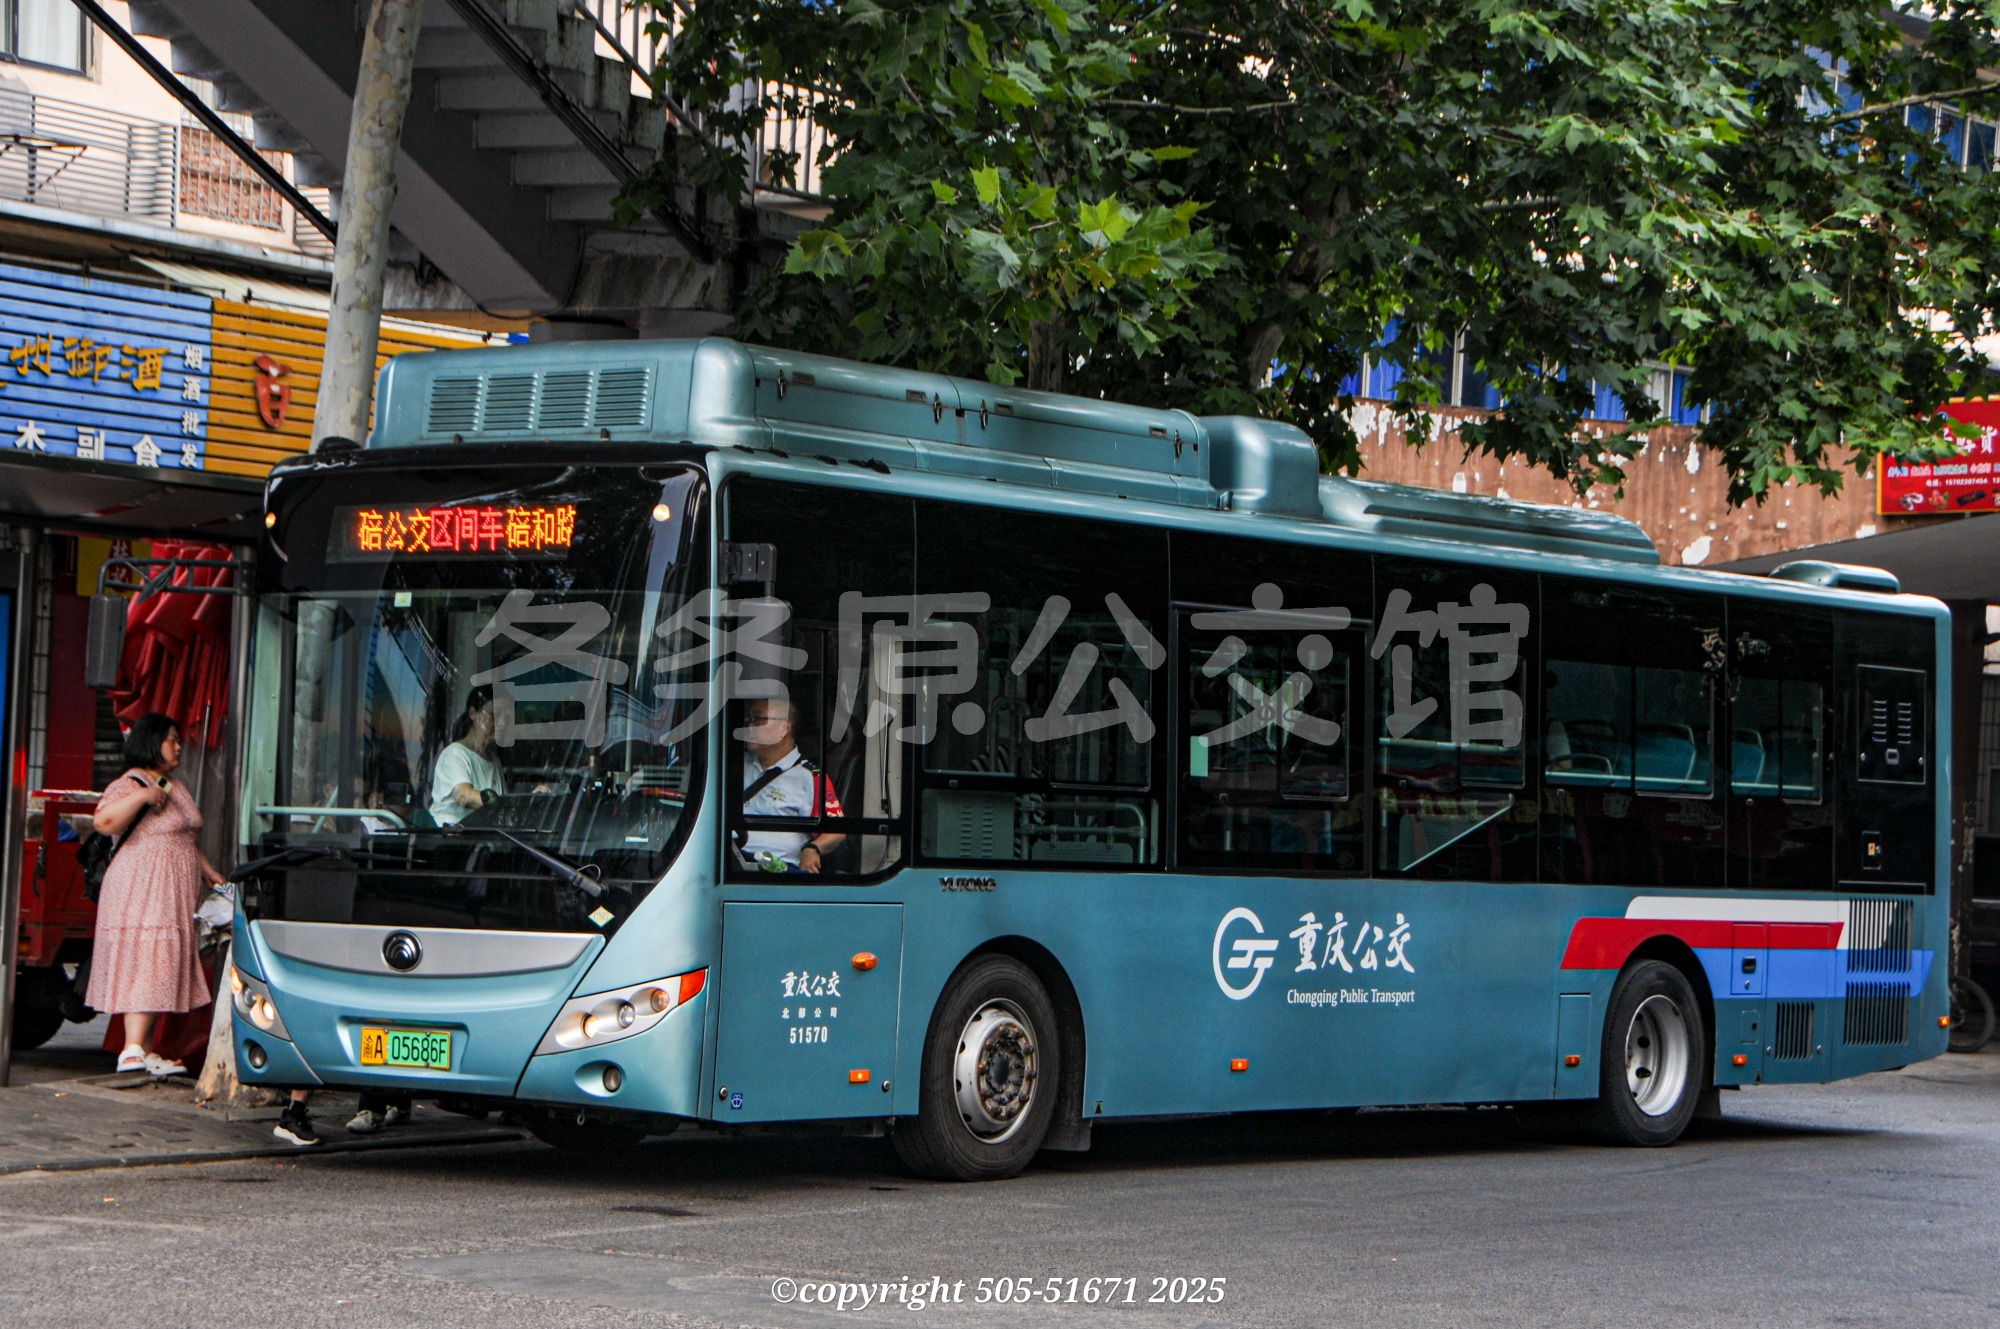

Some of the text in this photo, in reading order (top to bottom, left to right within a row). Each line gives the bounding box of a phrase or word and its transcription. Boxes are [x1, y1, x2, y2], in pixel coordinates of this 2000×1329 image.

[180, 343, 203, 469] 烟酒批发
[939, 877, 997, 892] YUTONG
[1288, 911, 1415, 973] 重庆公交
[780, 971, 842, 998] 重庆公交
[1287, 988, 1415, 1007] Chongqing Public Transport
[789, 1025, 828, 1045] 51570
